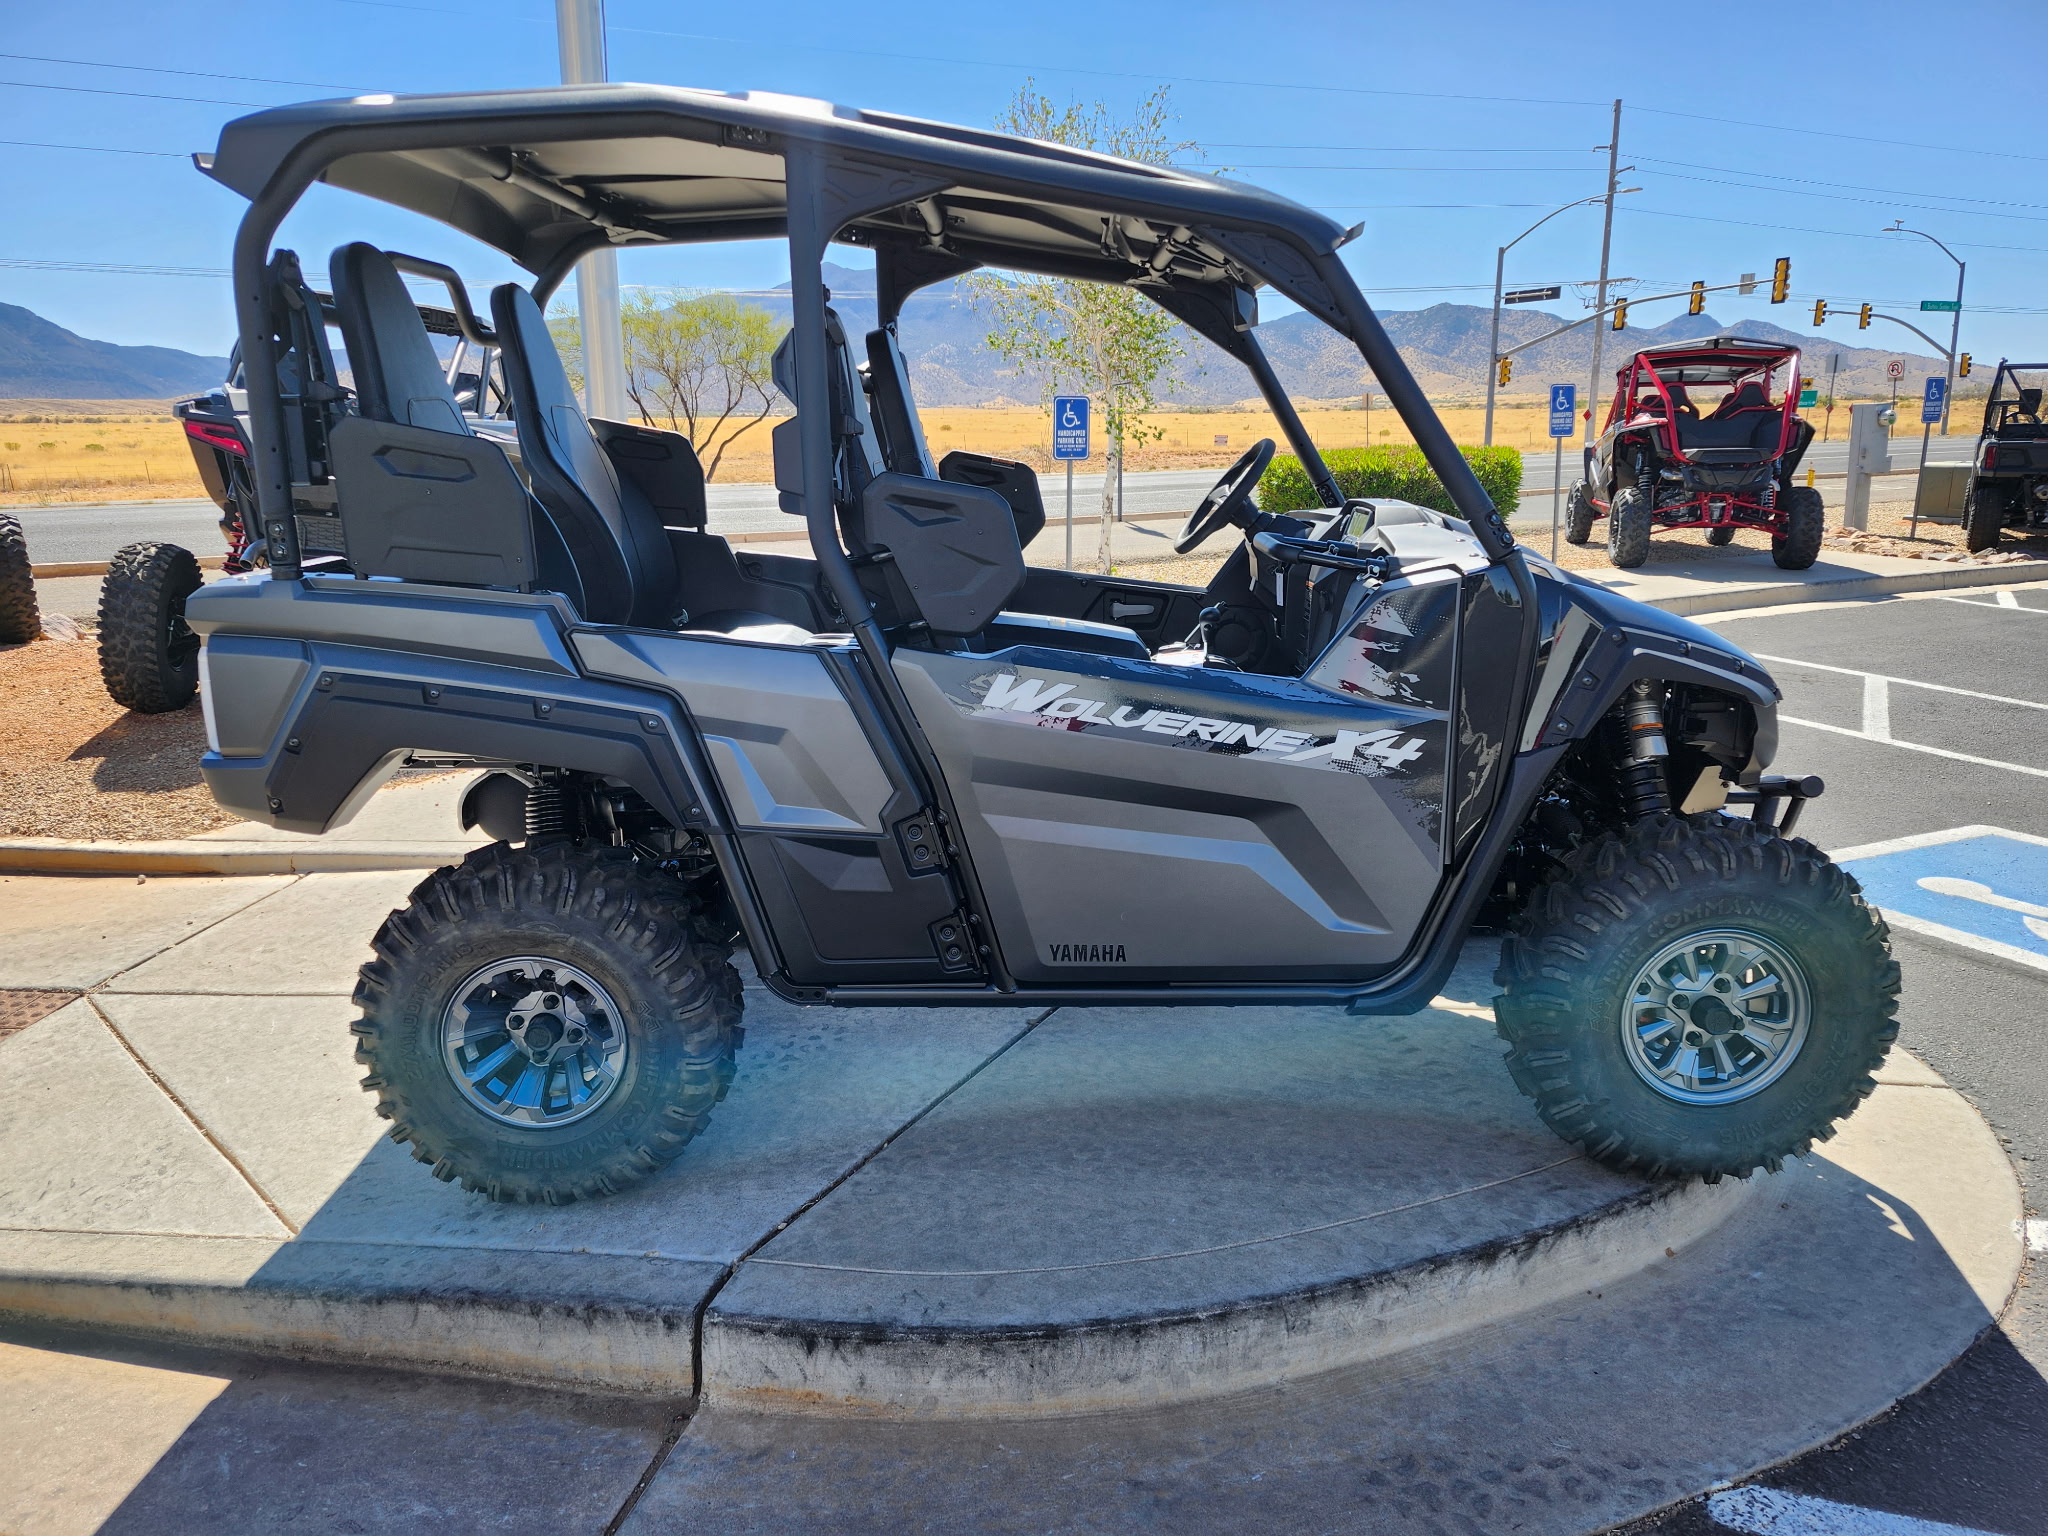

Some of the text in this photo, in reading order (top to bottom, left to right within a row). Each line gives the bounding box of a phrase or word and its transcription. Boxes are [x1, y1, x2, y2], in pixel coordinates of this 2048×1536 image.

[1057, 429, 1086, 437] HANDICAPPED
[981, 673, 1427, 768] WOLVERINE X4
[1049, 944, 1127, 962] YAMAHA
[1602, 898, 1809, 984] DIRT COMMANDER
